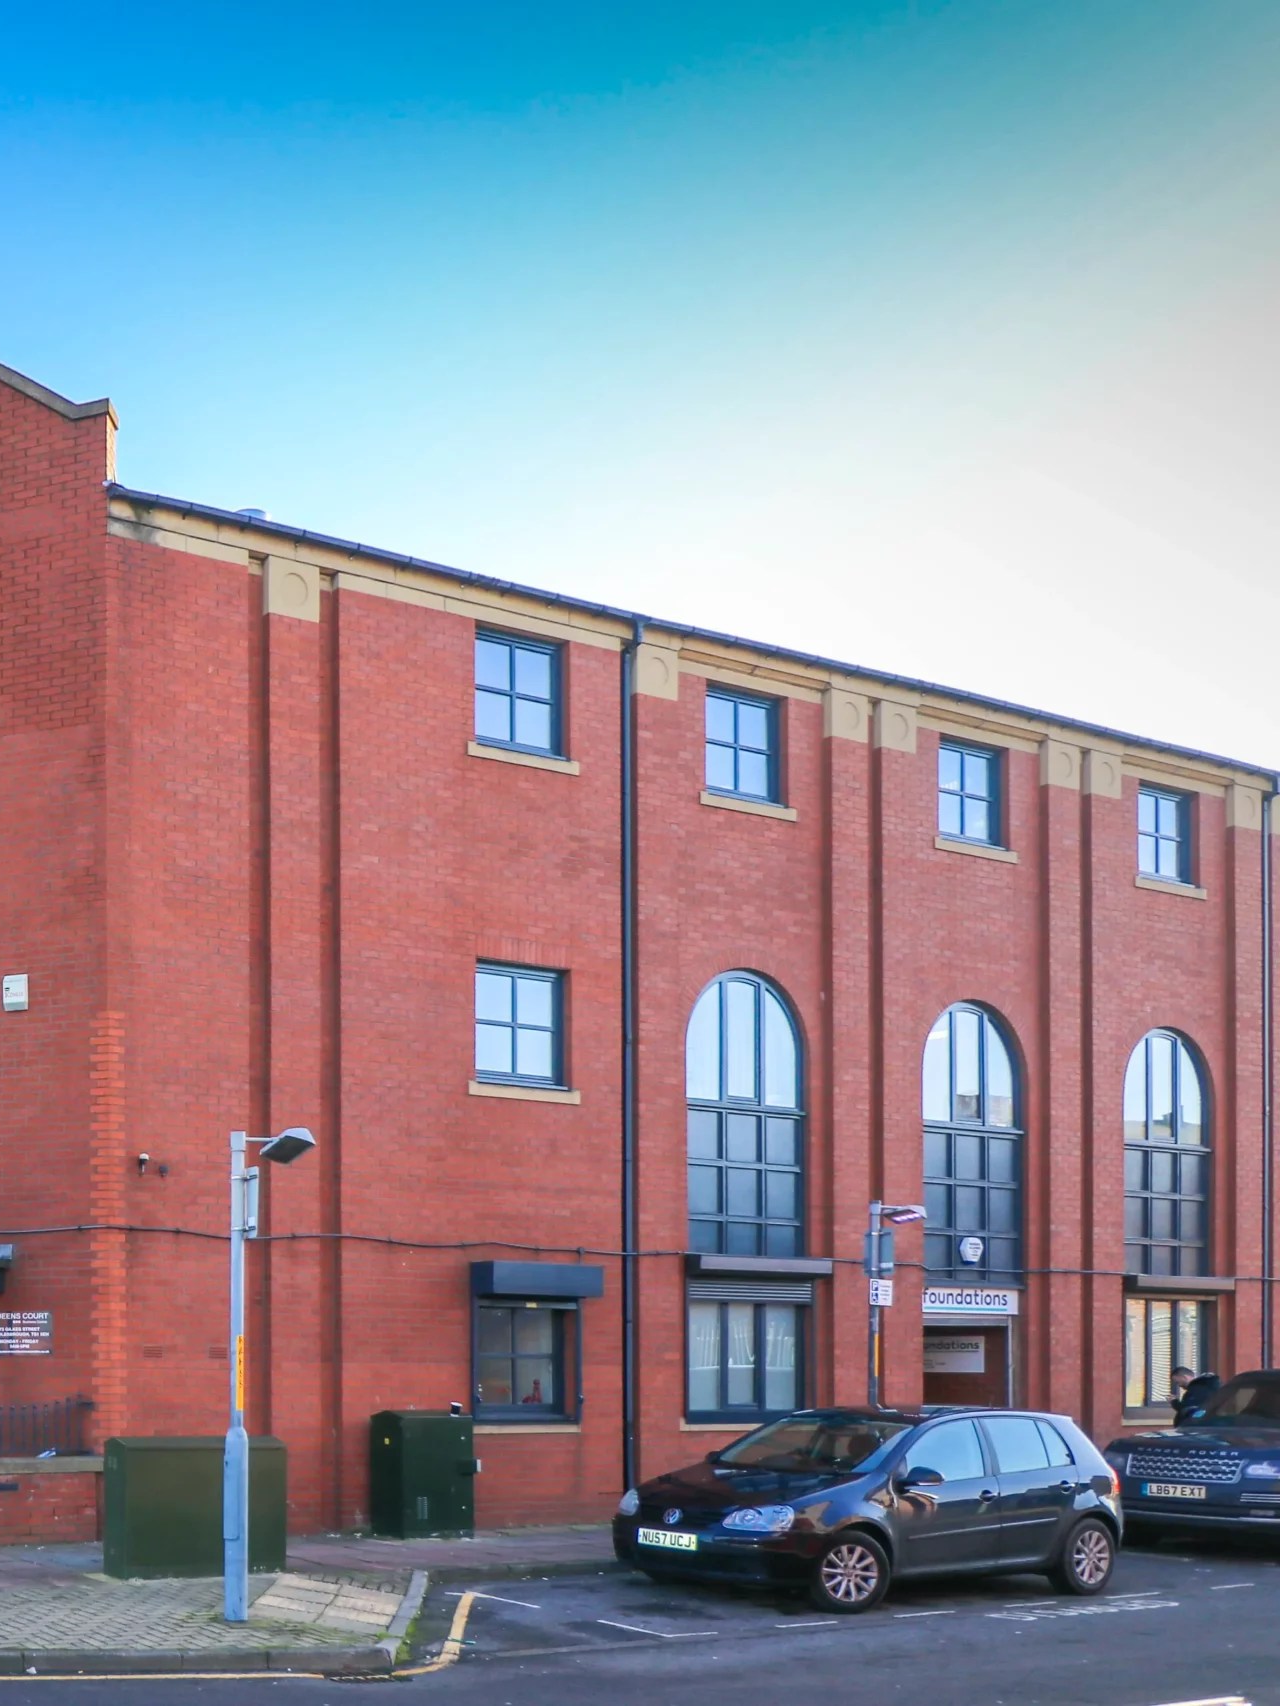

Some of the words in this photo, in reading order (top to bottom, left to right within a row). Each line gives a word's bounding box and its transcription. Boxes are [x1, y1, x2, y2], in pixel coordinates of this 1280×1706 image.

[923, 1287, 1008, 1306] foundations
[22, 1312, 49, 1320] COURT
[1188, 1449, 1240, 1457] ROVER
[1149, 1485, 1179, 1495] LB67
[1180, 1486, 1204, 1498] EXT
[642, 1530, 668, 1545] NU57
[669, 1534, 692, 1548] UCJ
